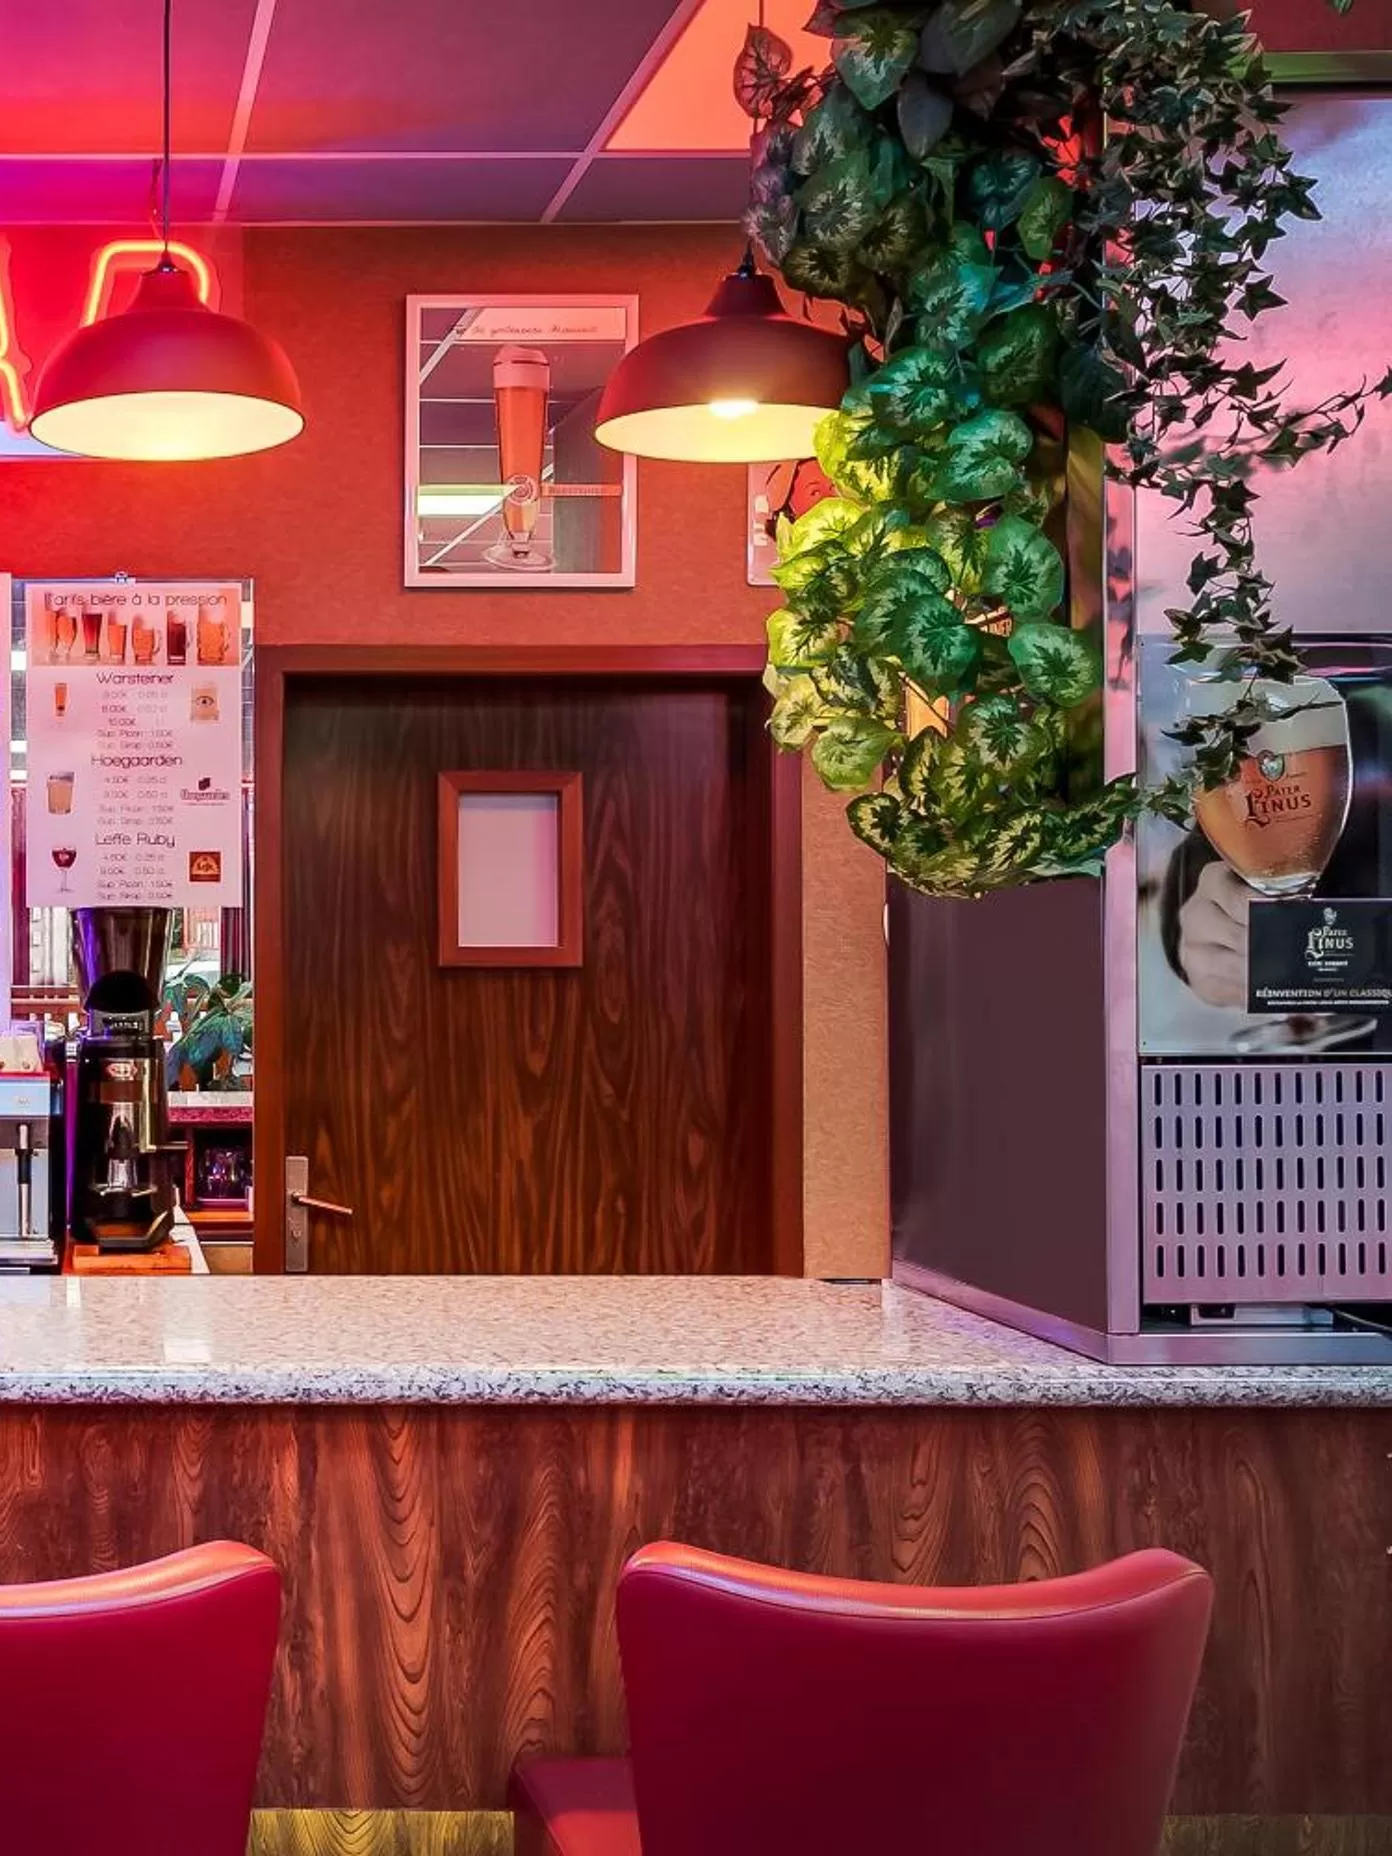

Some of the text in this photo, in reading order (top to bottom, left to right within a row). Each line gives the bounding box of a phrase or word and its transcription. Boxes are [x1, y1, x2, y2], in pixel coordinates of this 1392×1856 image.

[131, 593, 143, 606] à
[148, 594, 161, 606] la
[166, 594, 228, 606] pression
[95, 672, 175, 685] Warsteiner
[91, 754, 184, 769] Hoegaarden
[1244, 788, 1312, 829] LINUS
[94, 832, 175, 849] Leffe Ruby
[1305, 928, 1354, 959] LINUS
